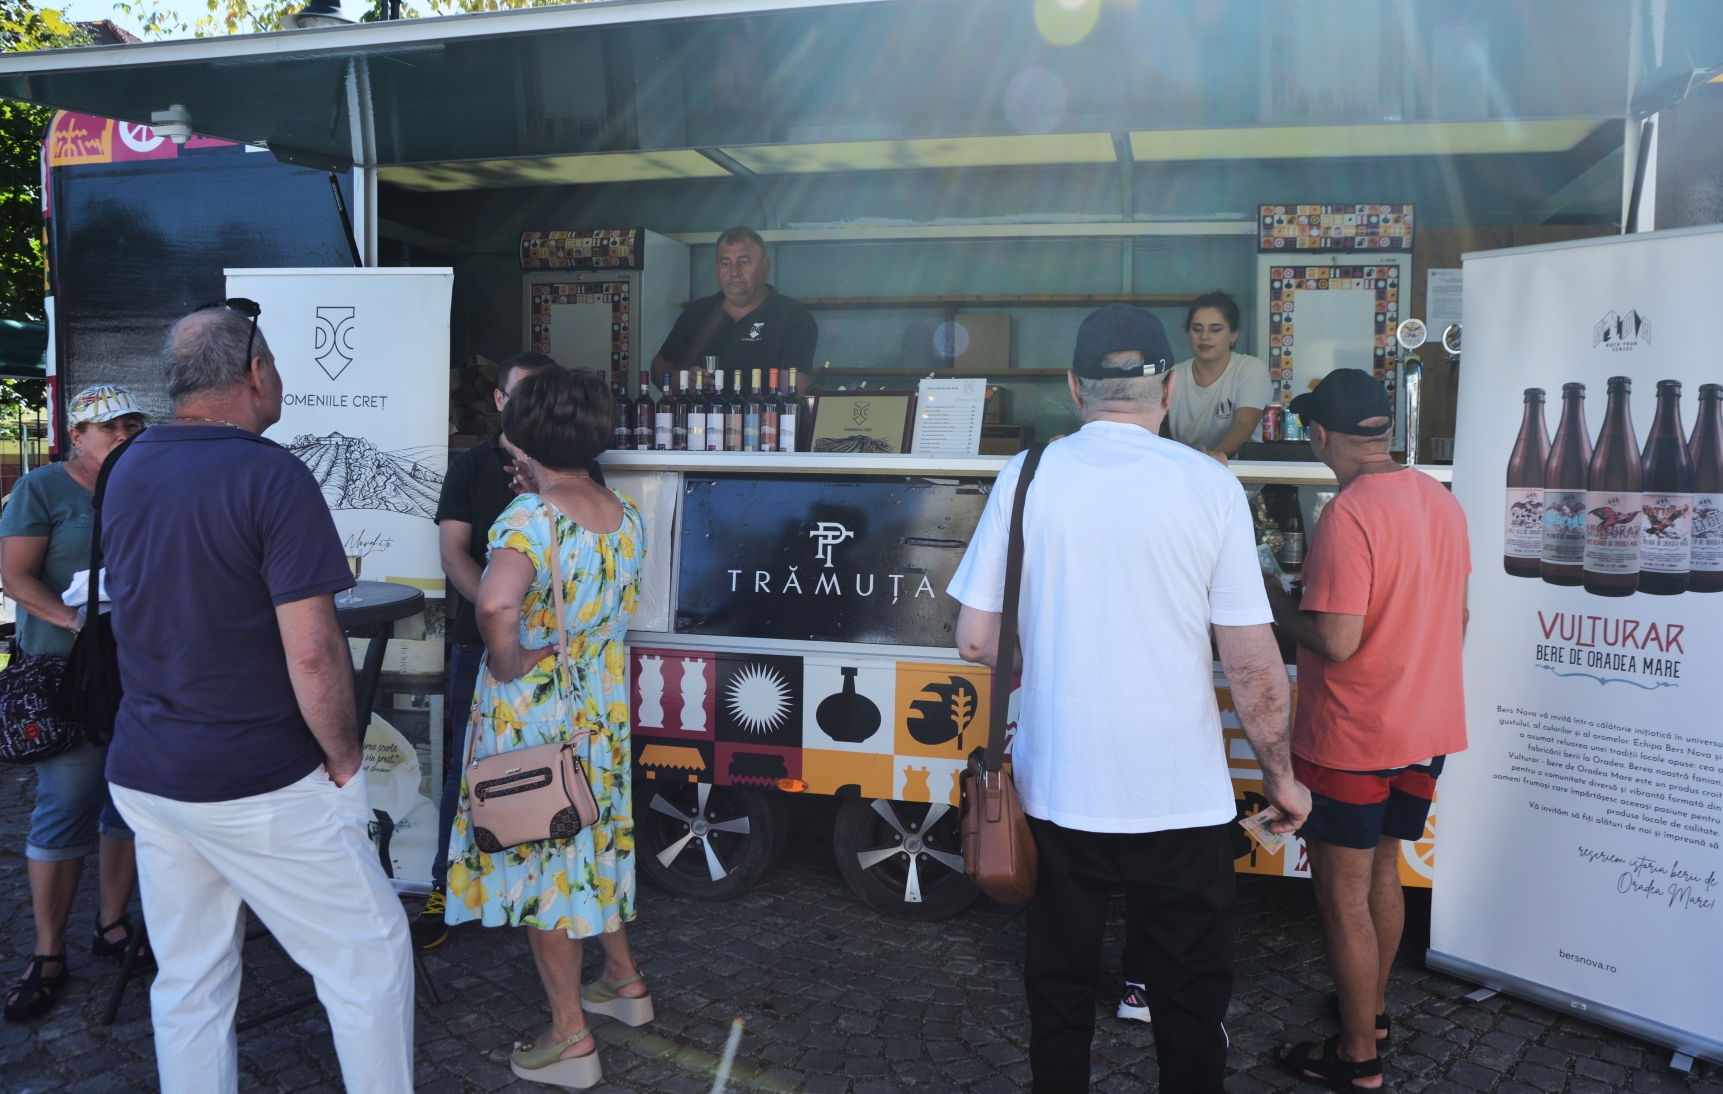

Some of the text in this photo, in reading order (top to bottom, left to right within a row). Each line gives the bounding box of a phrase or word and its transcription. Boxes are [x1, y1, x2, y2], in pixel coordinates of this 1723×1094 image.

[281, 393, 348, 408] OMENIILE
[727, 565, 936, 605] TRĂMUȚA
[1537, 610, 1685, 655] VULTURAR
[1536, 644, 1682, 679] BERE DE ORADEA MARE
[1497, 705, 1514, 714] Bers
[1516, 708, 1537, 717] Nova
[1550, 714, 1572, 723] invită
[1596, 721, 1632, 733] călătorie
[1674, 733, 1683, 741] în
[1533, 721, 1541, 729] al
[1542, 724, 1572, 734] culorilor
[1582, 730, 1591, 738] al
[1633, 738, 1662, 750] Echipa
[1665, 743, 1684, 754] Bers
[1687, 747, 1712, 759] Nova
[1526, 734, 1555, 743] asumat
[1556, 738, 1588, 750] reluarea
[1610, 748, 1638, 759] tradiții
[1640, 751, 1665, 763] locale
[1698, 764, 1715, 772] cea
[1527, 743, 1561, 756] fabricării
[1563, 750, 1581, 760] berii
[1582, 753, 1590, 762] la
[1592, 755, 1626, 768] Oradea.
[1628, 762, 1653, 773] Berea
[1656, 769, 1689, 780] noastră
[1508, 751, 1539, 763] Vulturar
[1546, 758, 1563, 768] bere
[1565, 762, 1575, 771] de
[1577, 764, 1608, 777] Oradea
[1610, 771, 1633, 782] Mare
[1635, 778, 1653, 786] este
[1668, 784, 1699, 795] produs
[1701, 790, 1722, 798] croit
[1511, 765, 1536, 774] pentru
[1544, 772, 1587, 785] comunitate
[1588, 779, 1618, 791] diversă
[1620, 786, 1627, 794] și
[1629, 787, 1665, 800] vibrantă
[1668, 793, 1704, 808] formată
[1707, 802, 1722, 811] din
[1492, 774, 1521, 783] oameni
[1523, 776, 1550, 790] frumoși
[1552, 785, 1568, 793] care
[1620, 799, 1652, 811] aceeași
[1654, 806, 1688, 818] pasiune
[1691, 813, 1721, 824] pentru
[1529, 801, 1539, 810] Vă
[1582, 812, 1593, 823] fiți
[1595, 816, 1623, 828] alături
[1625, 822, 1636, 831] de
[1663, 831, 1706, 846] împreună
[1606, 808, 1640, 820] produse
[1642, 813, 1668, 826] locale
[1670, 819, 1682, 829] de
[1617, 871, 1664, 900] Oradea
[1704, 871, 1718, 892] de
[1559, 949, 1617, 973] bersnova.ro
